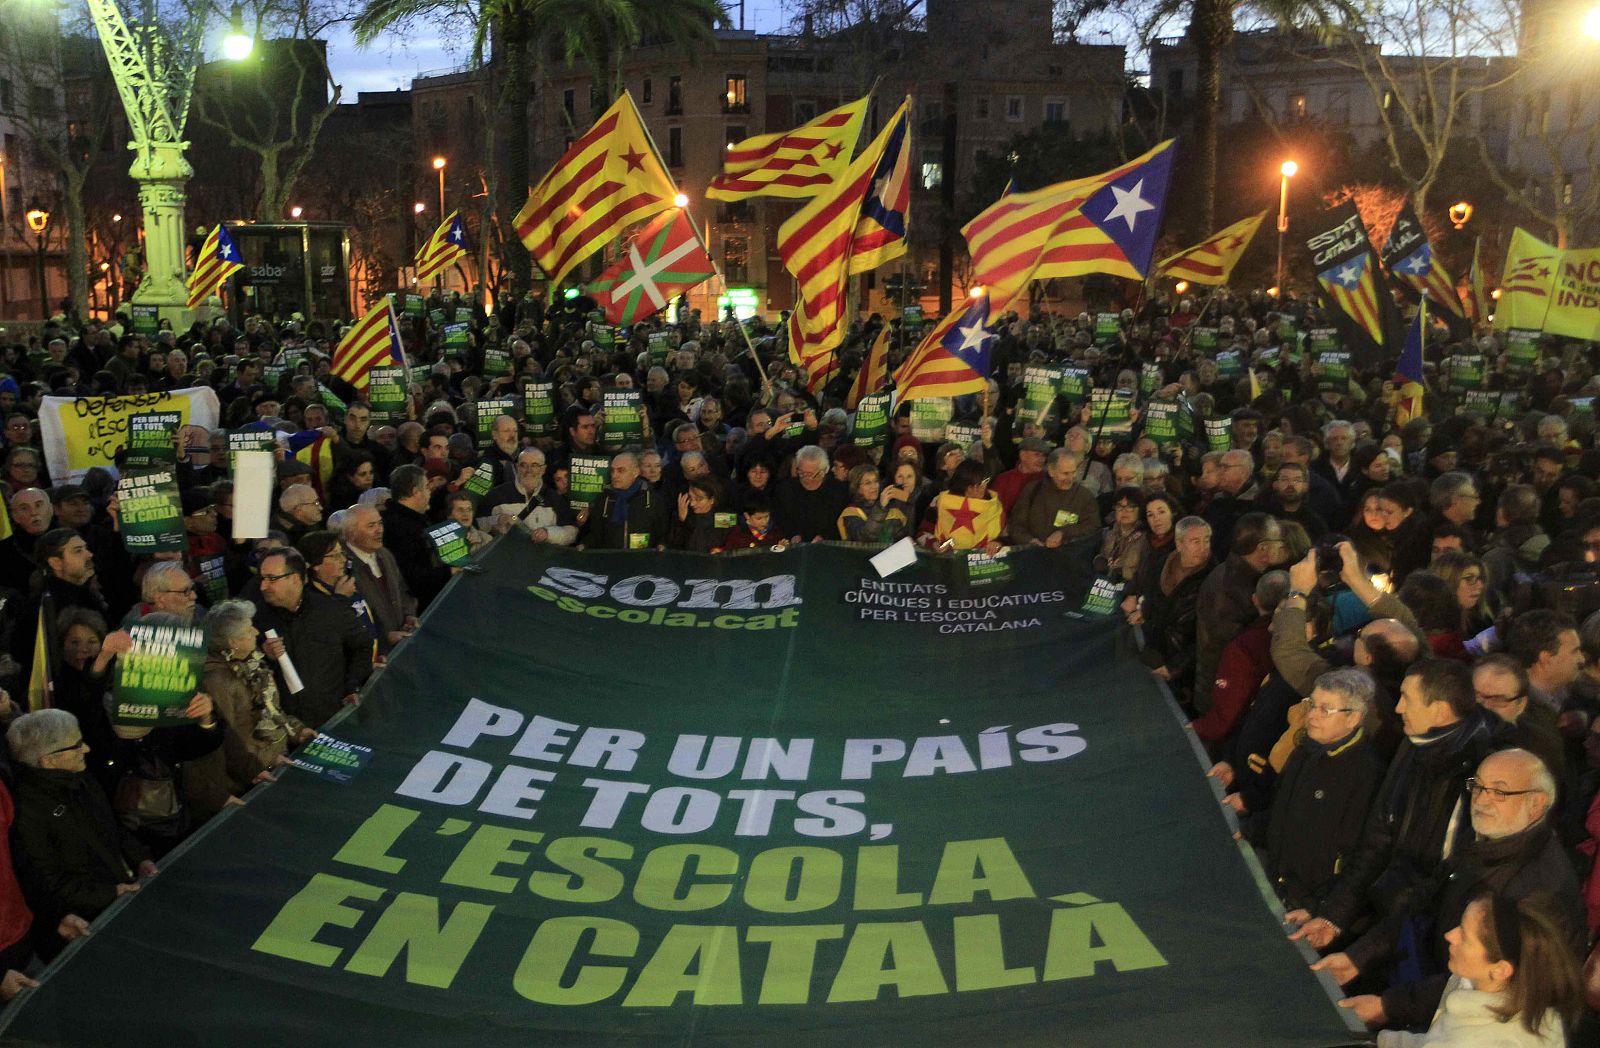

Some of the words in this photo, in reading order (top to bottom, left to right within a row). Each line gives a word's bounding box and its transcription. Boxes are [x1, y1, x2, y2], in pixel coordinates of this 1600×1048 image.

[251, 264, 281, 277] saba
[160, 414, 178, 423] PAÍS
[229, 433, 243, 441] PER
[256, 431, 273, 440] PAÍS
[118, 478, 134, 489] PER
[134, 476, 149, 487] UN
[149, 472, 172, 484] PAÍS
[117, 489, 131, 500] DE
[861, 578, 948, 594] ENTITATS
[527, 586, 800, 631] escola.cat
[844, 591, 931, 609] CÍVIQUES
[936, 599, 943, 610] I
[948, 590, 1066, 610] EDUCATIVES
[860, 608, 898, 621] PER
[904, 609, 998, 623] L'ESCOLA
[130, 625, 154, 640] PER
[938, 617, 1043, 635] CATALANA
[441, 697, 645, 772] PER
[667, 734, 814, 780] UN
[841, 722, 1087, 780] PAÍS
[394, 750, 556, 820] DE
[580, 777, 894, 840] TOTS,
[332, 803, 1037, 912] L'ESCOLA
[250, 872, 496, 989] EN
[512, 892, 1170, 1007] CATALÀ
